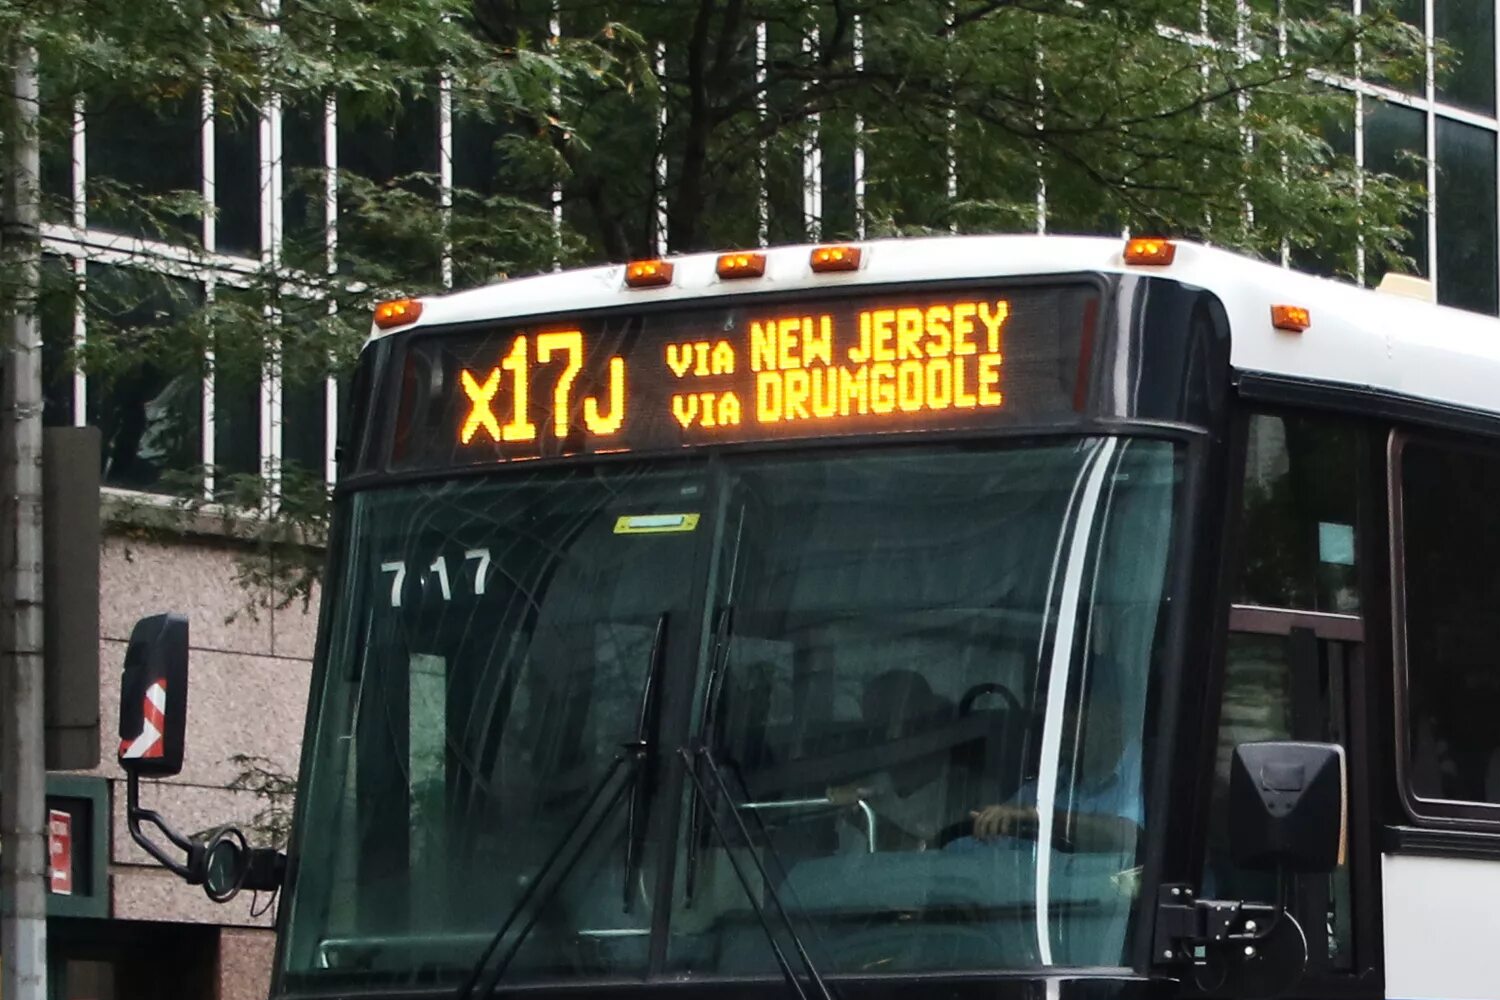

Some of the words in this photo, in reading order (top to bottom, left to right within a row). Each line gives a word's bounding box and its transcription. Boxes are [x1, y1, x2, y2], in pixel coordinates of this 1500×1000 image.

[665, 341, 736, 377] VIA
[750, 314, 832, 372] NEW
[847, 300, 1009, 364] JERSEY
[672, 391, 741, 429] VIA
[756, 353, 1003, 423] DRUMGOOLE
